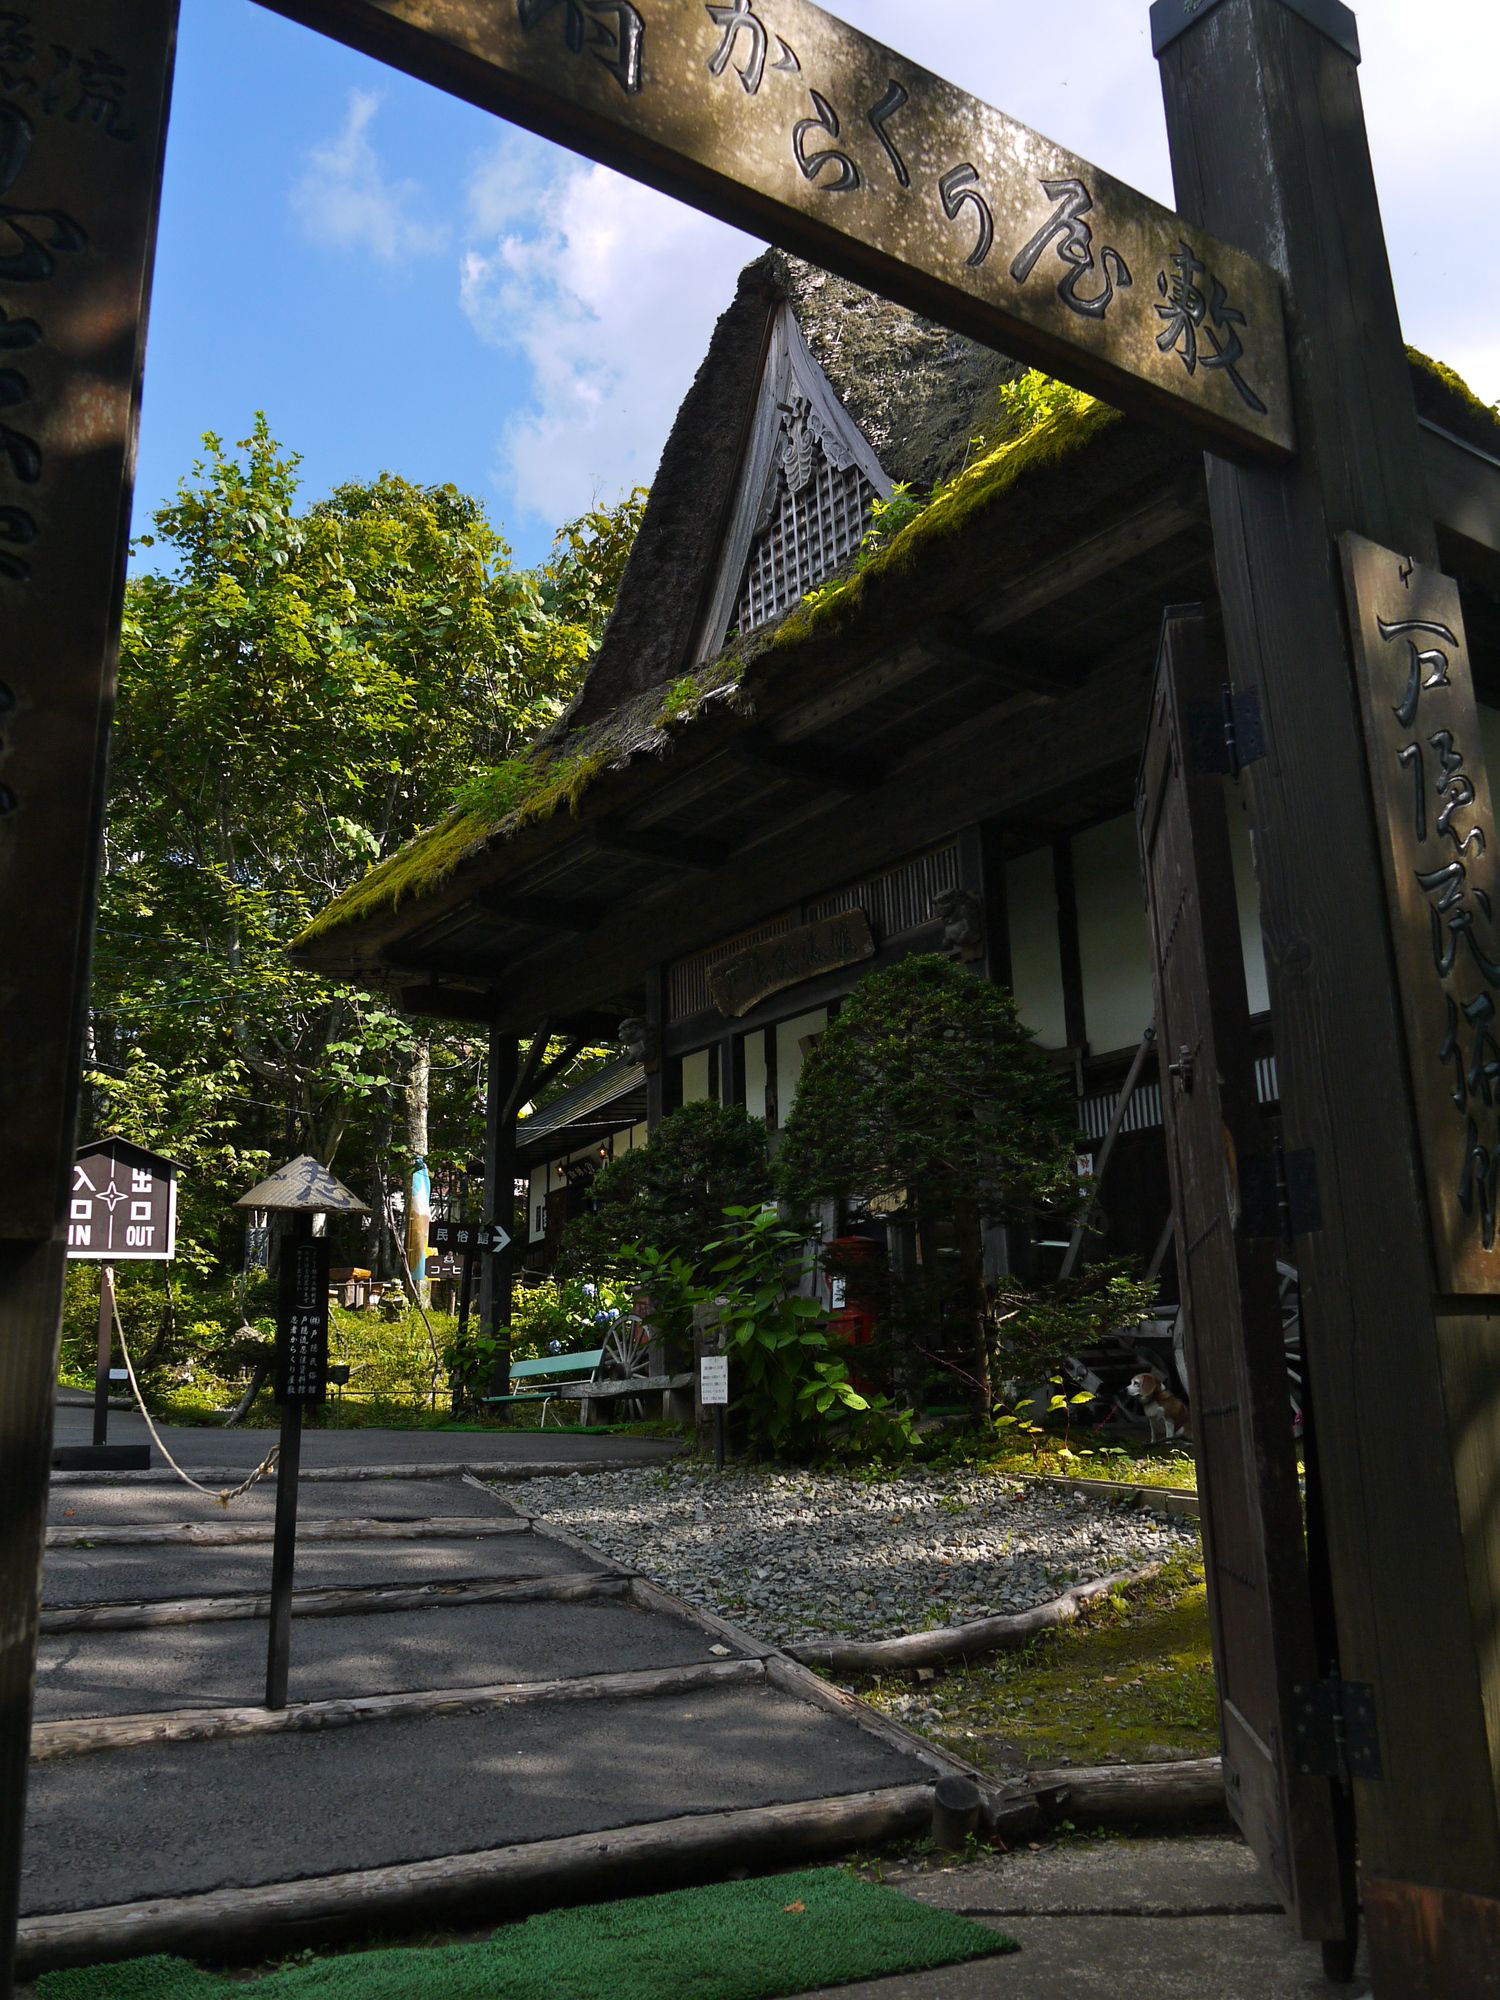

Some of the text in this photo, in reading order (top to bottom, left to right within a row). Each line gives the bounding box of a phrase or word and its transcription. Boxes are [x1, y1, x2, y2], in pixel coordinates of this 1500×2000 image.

[70, 1165, 96, 1219] 入口
[130, 1167, 152, 1221] 出口
[67, 1224, 91, 1246] IN
[126, 1225, 155, 1247] OUT
[436, 1228, 490, 1245] 民俗館
[430, 1265, 462, 1275] コーヒ
[287, 1315, 298, 1395] 忍者からくり屋敷
